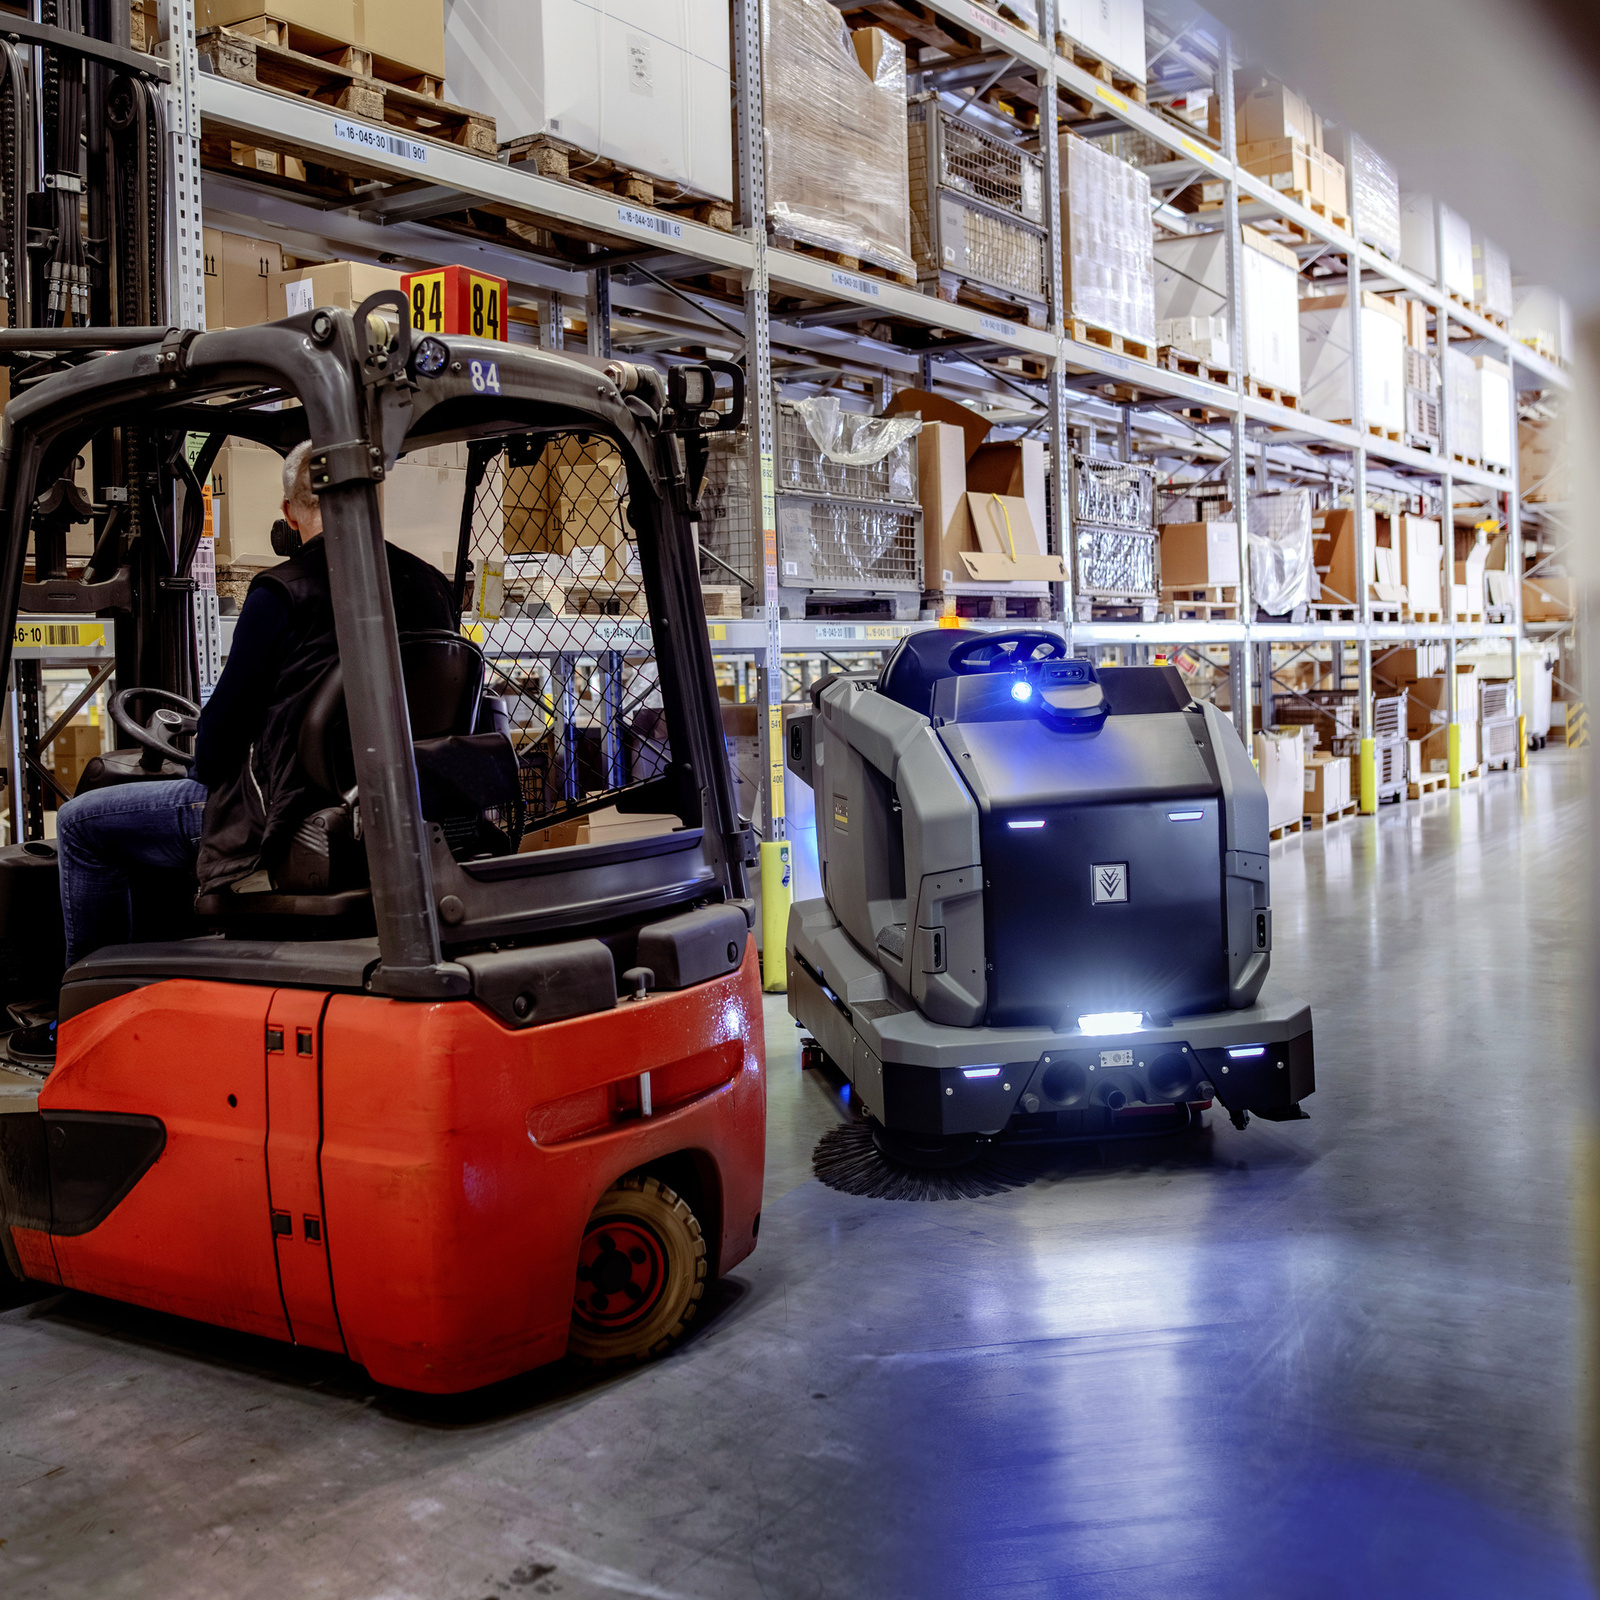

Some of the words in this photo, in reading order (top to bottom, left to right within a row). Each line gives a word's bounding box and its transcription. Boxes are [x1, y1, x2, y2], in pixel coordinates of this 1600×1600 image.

[346, 126, 386, 149] 16-045-30
[412, 146, 426, 161] 901
[625, 210, 655, 229] 16-044-30
[673, 225, 682, 237] 42
[413, 280, 443, 333] 84
[472, 283, 499, 341] 84
[470, 360, 501, 394] 84
[771, 720, 781, 729] 541
[772, 774, 783, 784] 400
